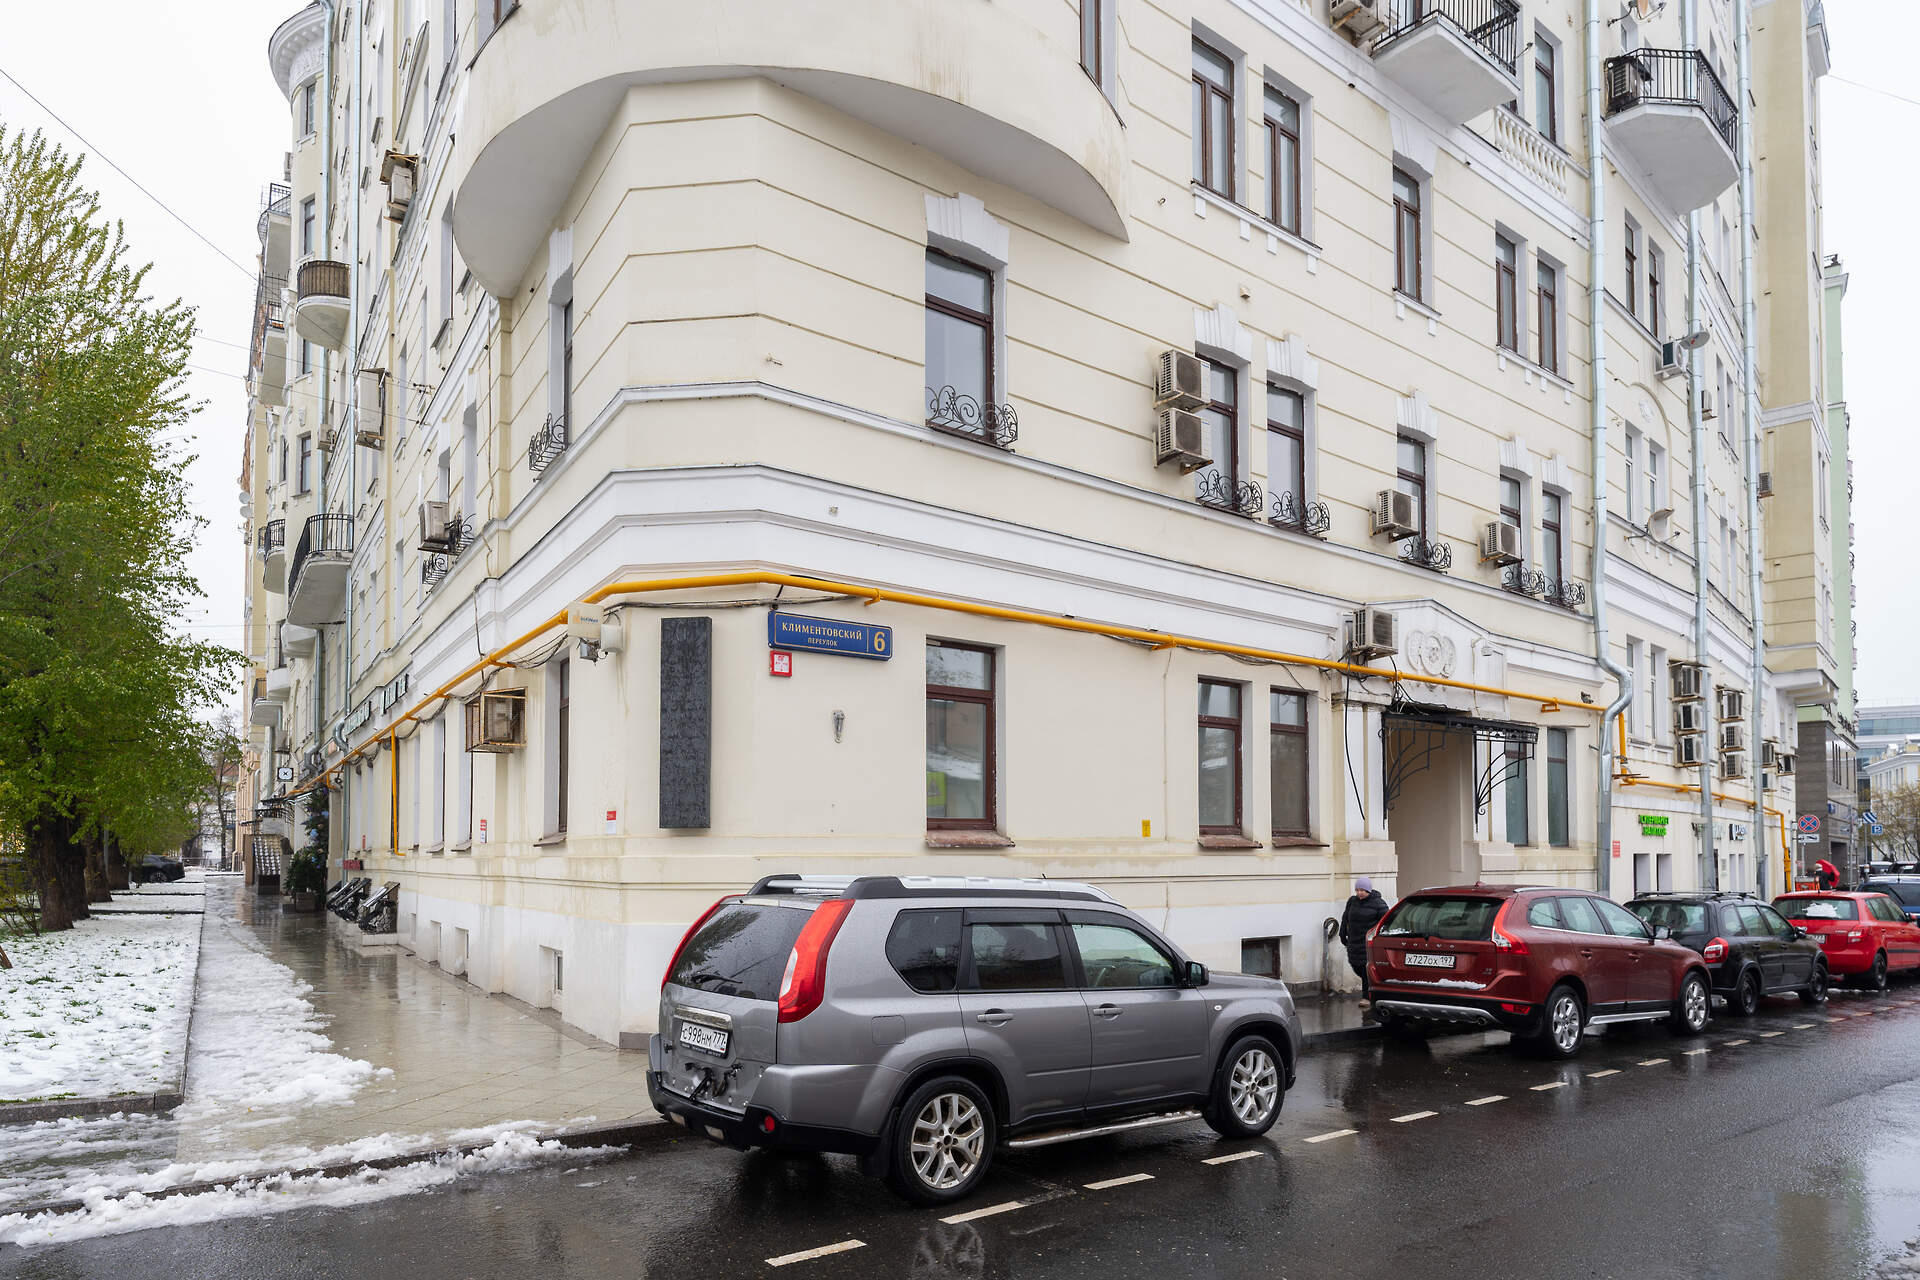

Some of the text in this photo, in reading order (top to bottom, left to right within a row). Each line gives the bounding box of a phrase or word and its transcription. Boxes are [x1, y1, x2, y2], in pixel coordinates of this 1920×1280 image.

[782, 622, 886, 652] КЛИМЕНТОВСКИЙ 6
[807, 637, 838, 647] ПЕРЕУЛОК
